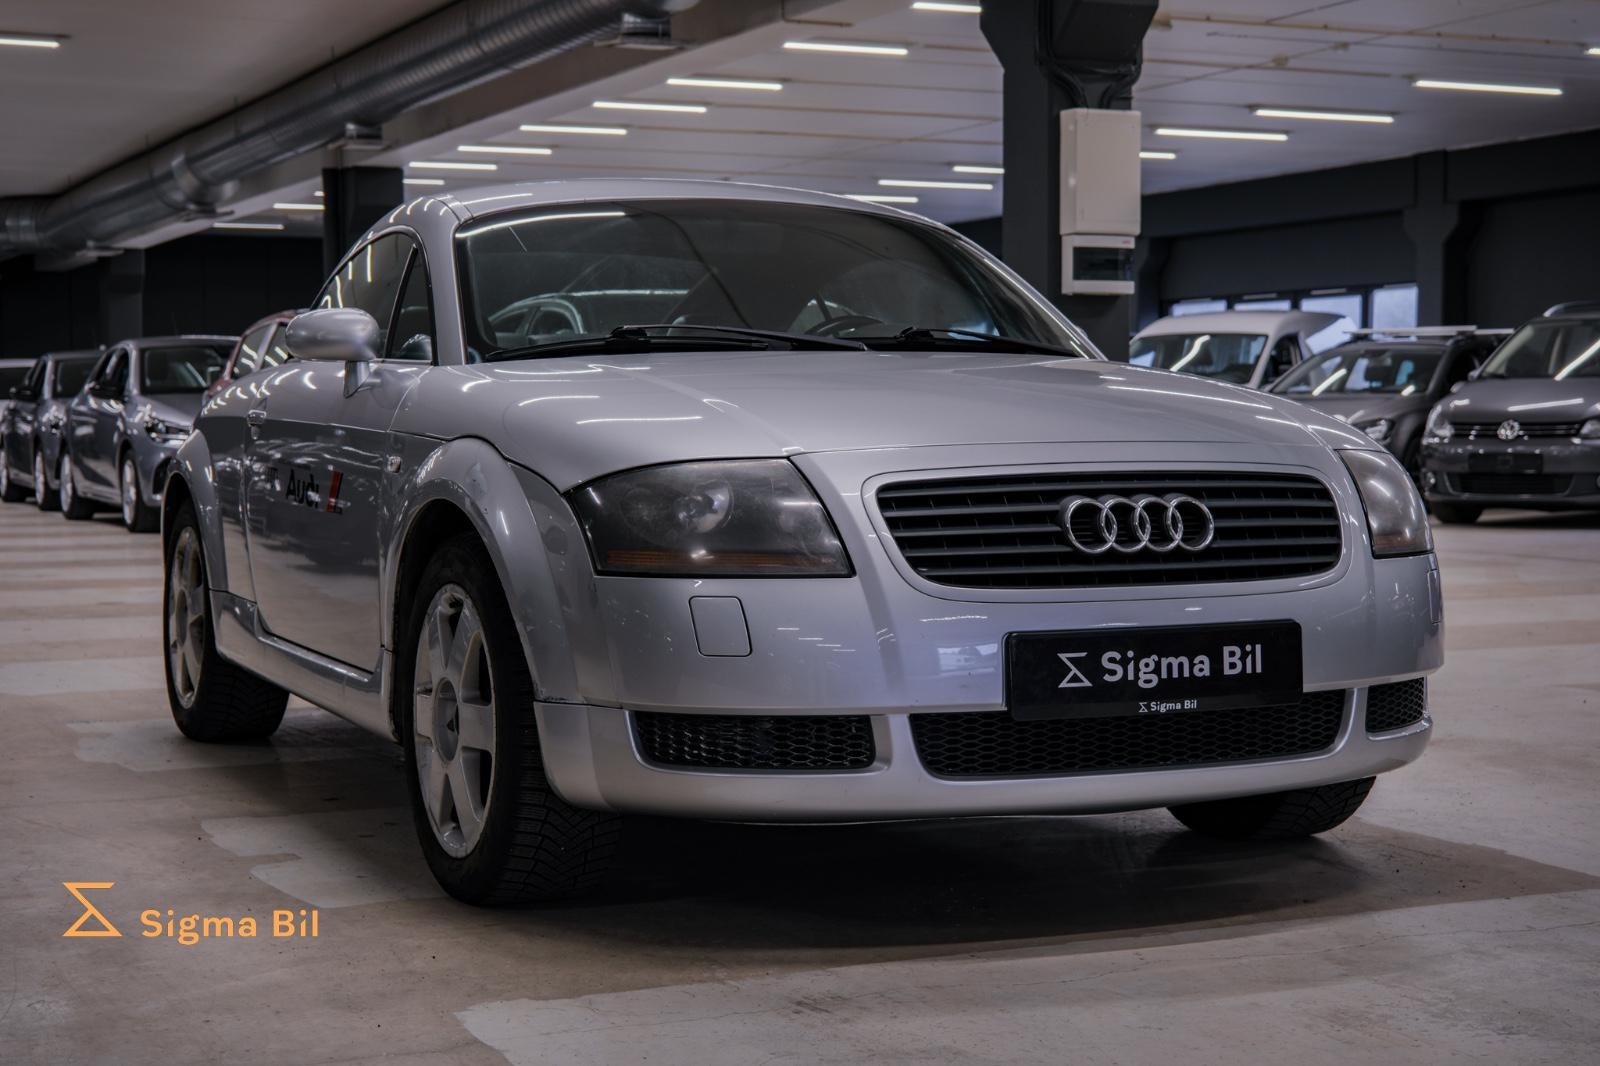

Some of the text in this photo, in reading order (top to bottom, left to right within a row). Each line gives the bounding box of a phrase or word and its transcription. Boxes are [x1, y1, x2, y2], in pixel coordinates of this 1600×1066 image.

[1101, 644, 1262, 689] Sigma Bil
[1150, 700, 1197, 713] Sigma Bil
